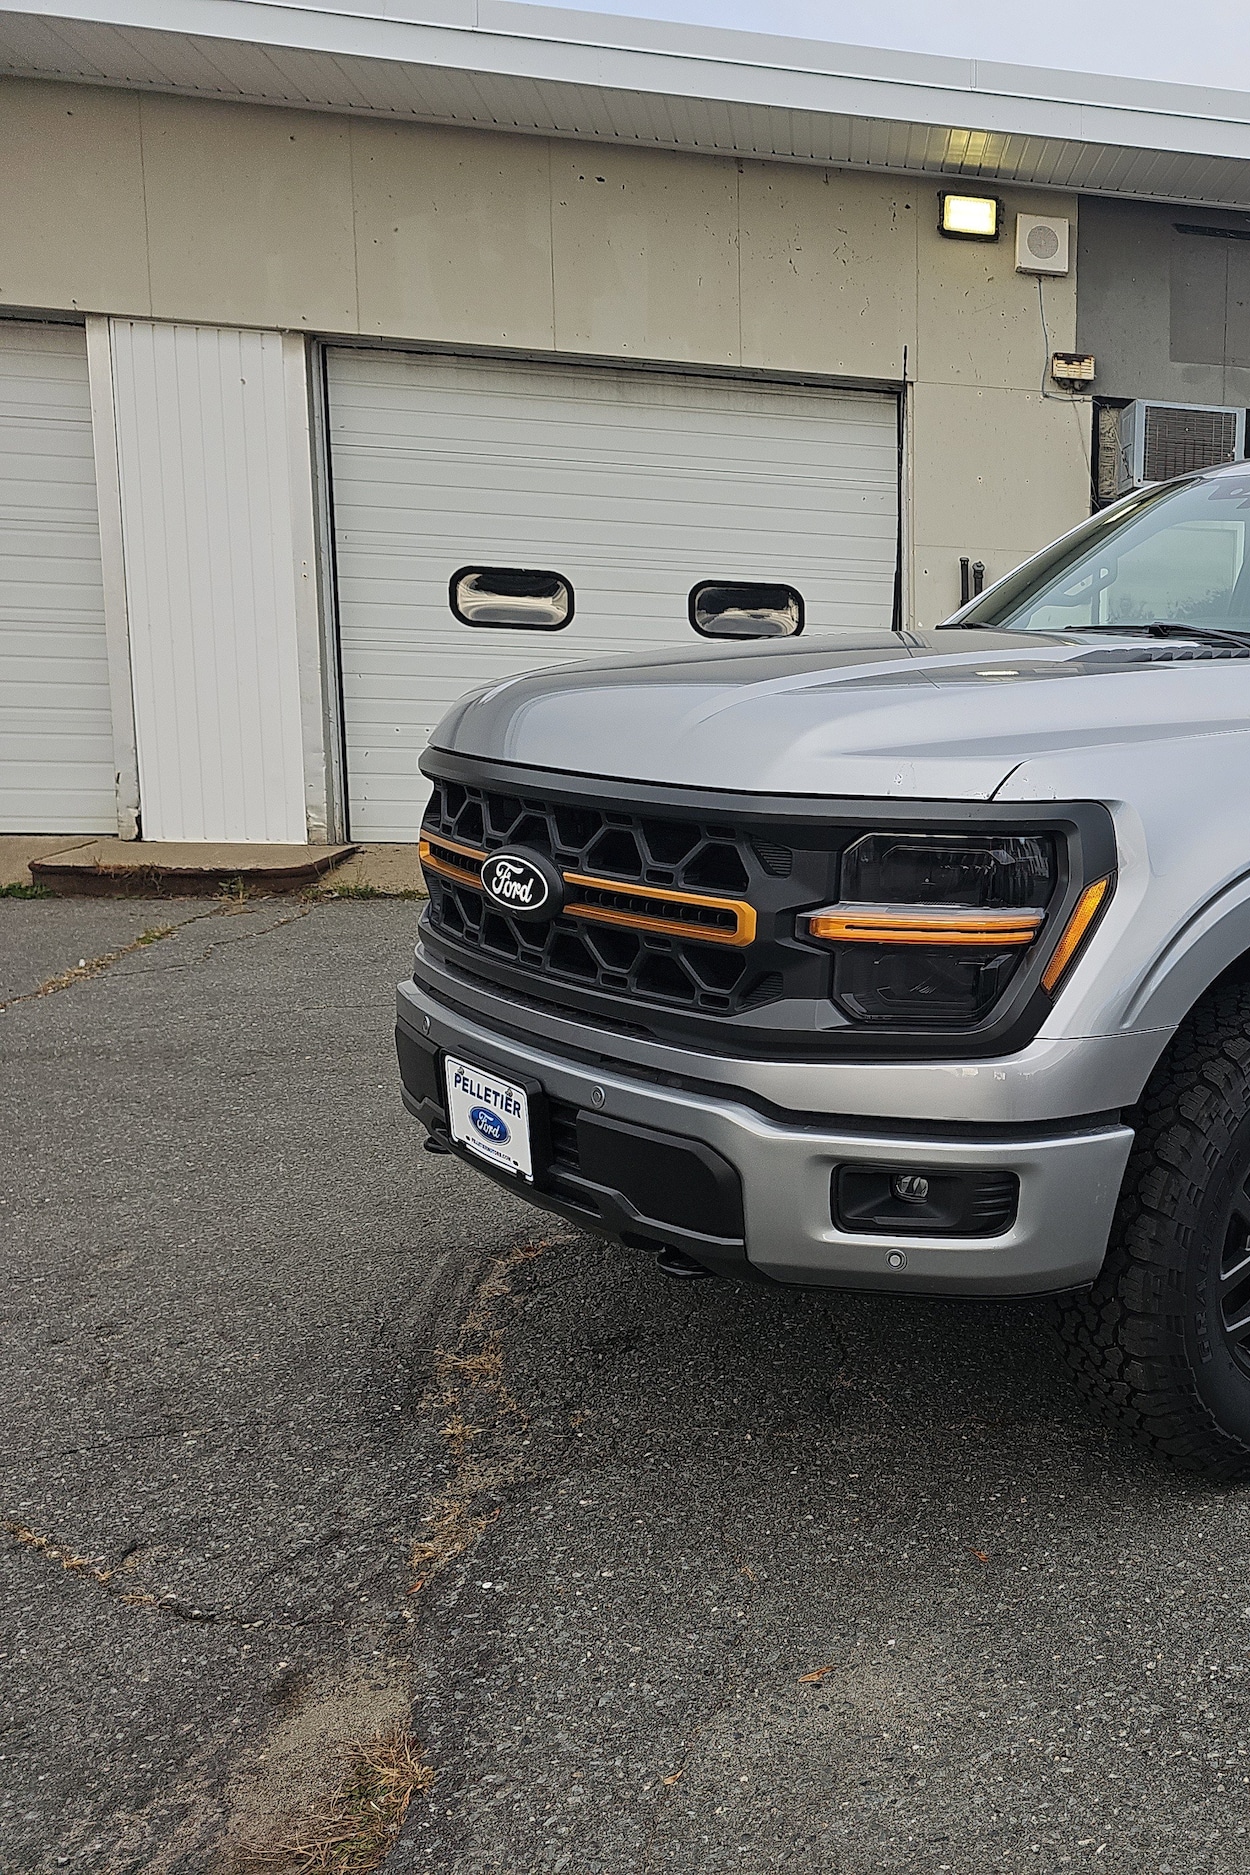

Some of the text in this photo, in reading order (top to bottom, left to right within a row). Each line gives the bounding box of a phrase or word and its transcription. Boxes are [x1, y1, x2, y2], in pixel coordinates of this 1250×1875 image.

[492, 861, 534, 903] Ford
[454, 1073, 521, 1118] PELLETIER
[476, 1111, 501, 1139] Ford
